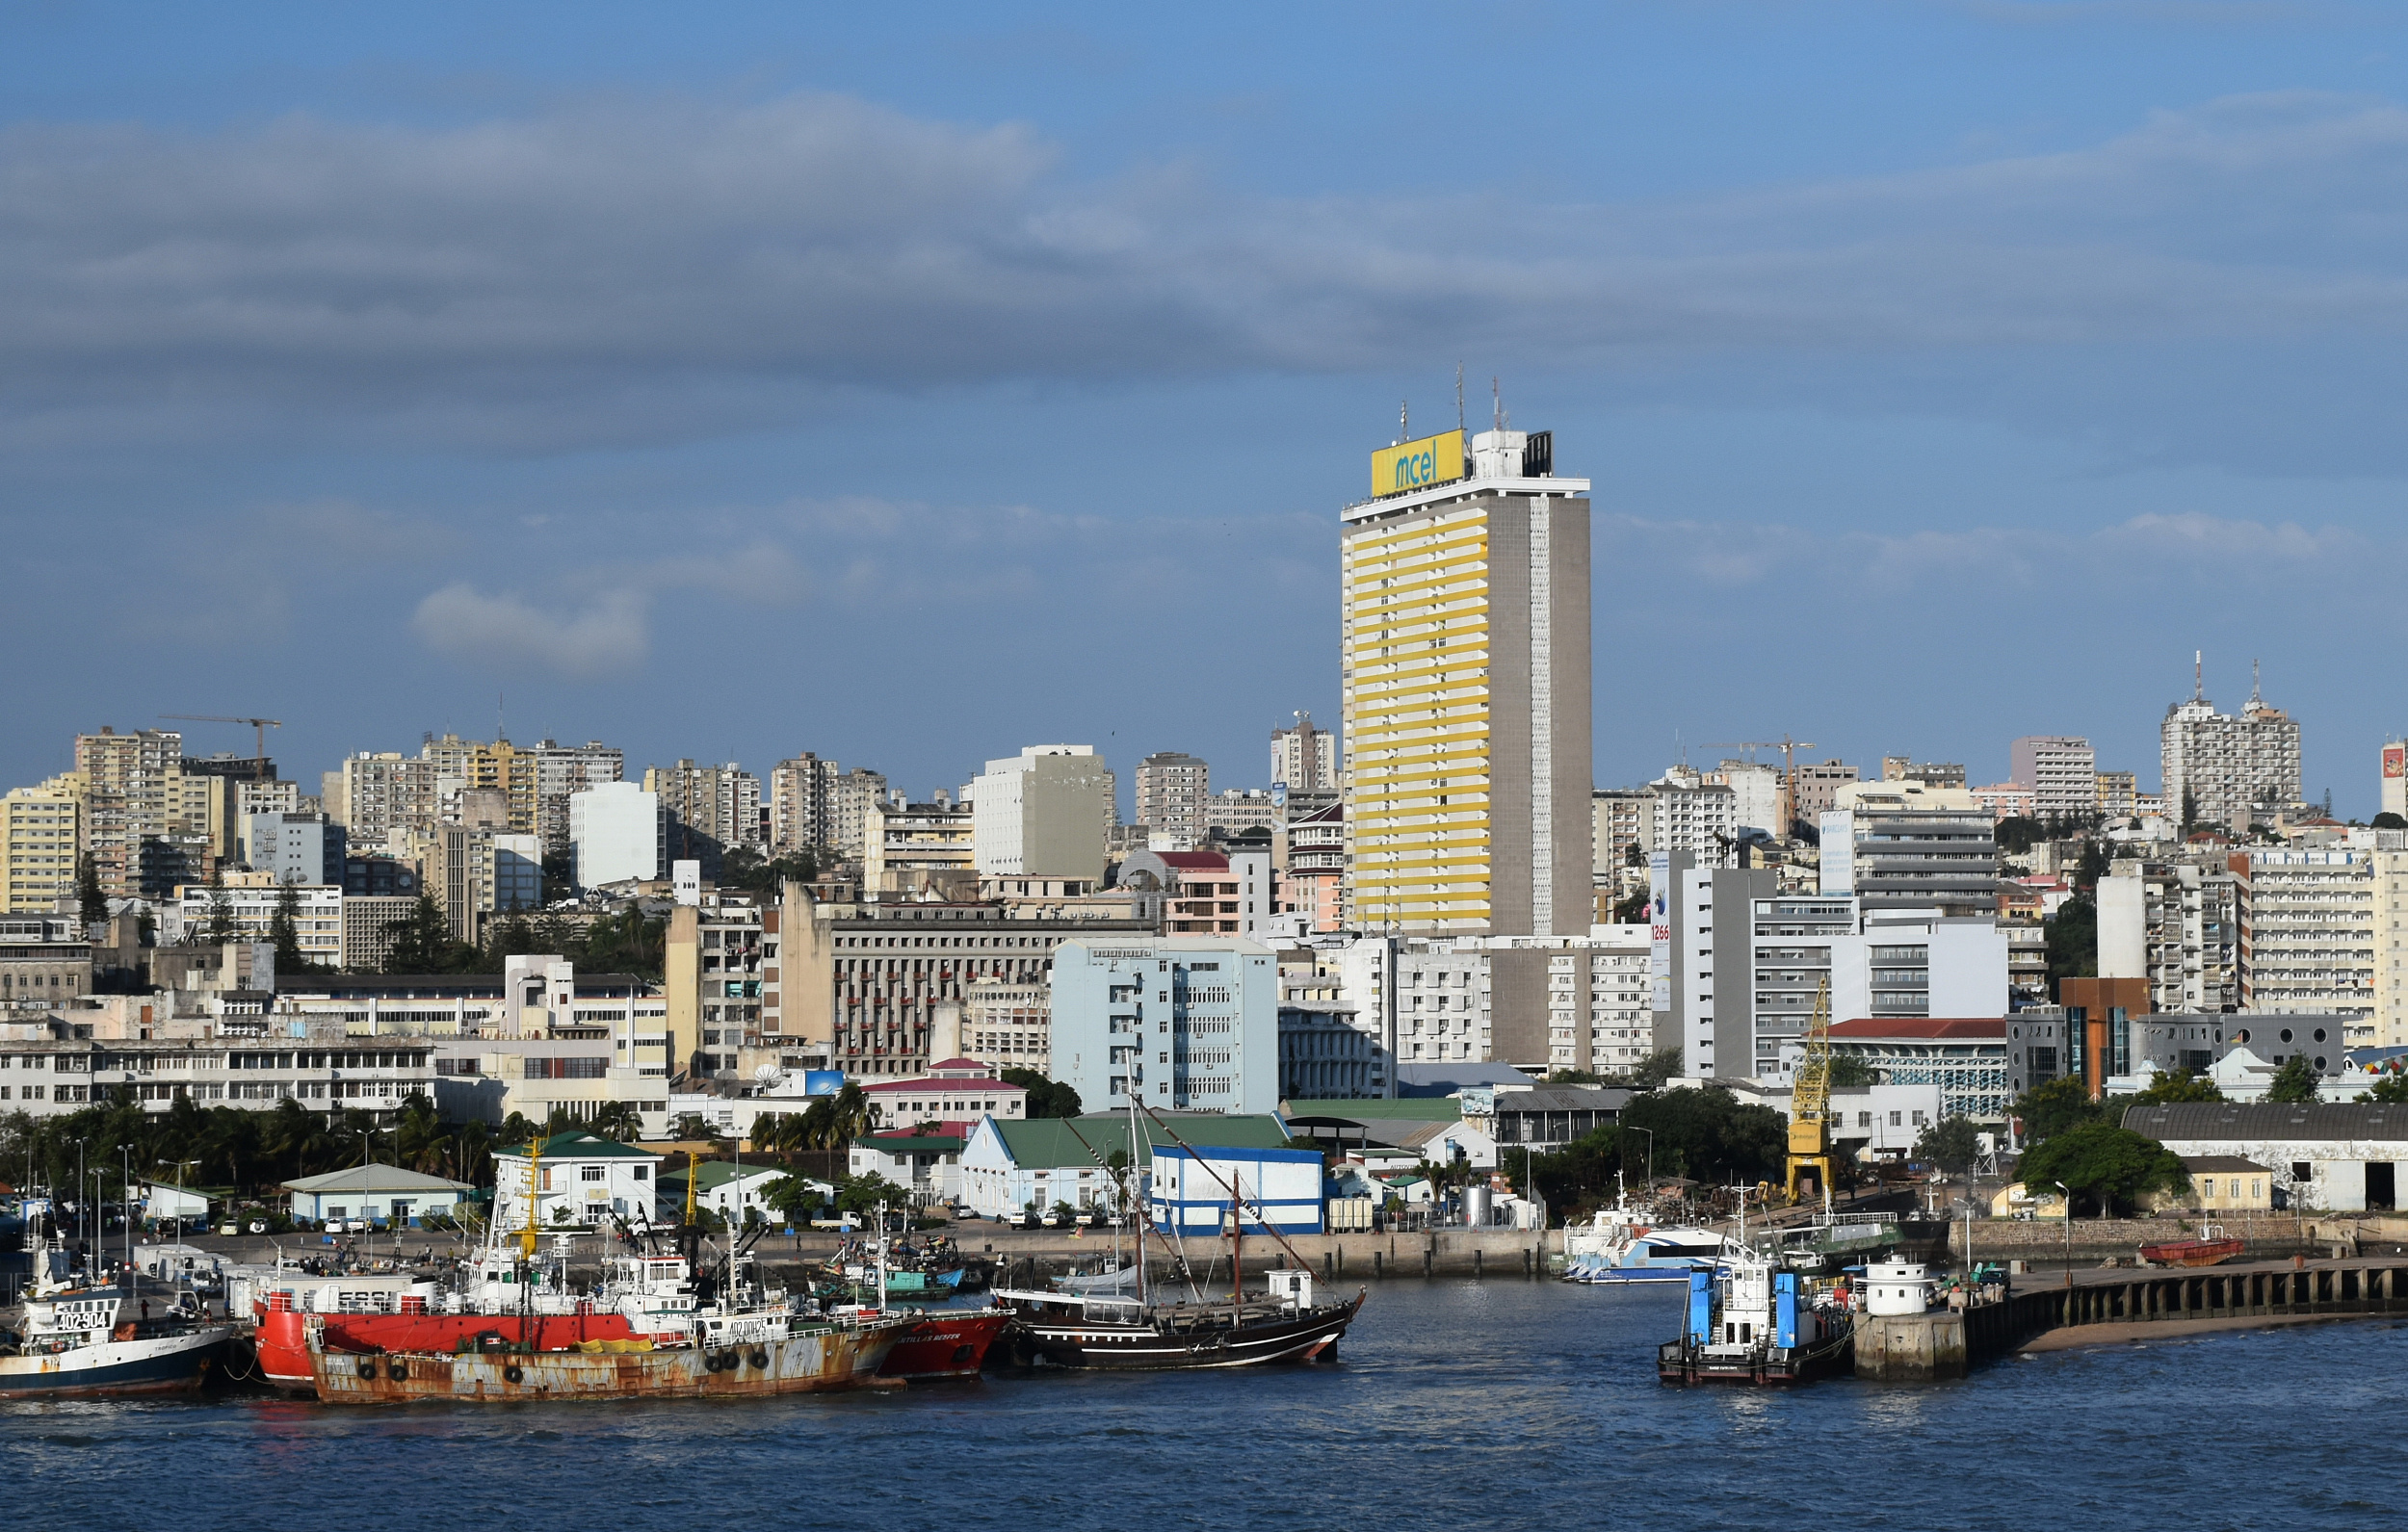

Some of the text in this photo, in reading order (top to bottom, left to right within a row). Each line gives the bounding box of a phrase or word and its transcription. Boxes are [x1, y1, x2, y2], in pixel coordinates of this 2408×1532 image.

[1397, 439, 1437, 487] mcel
[1826, 824, 1847, 833] BARCLAYS
[1652, 924, 1669, 940] 1266
[59, 1312, 106, 1331] 402-904
[932, 1333, 961, 1341] REEFER
